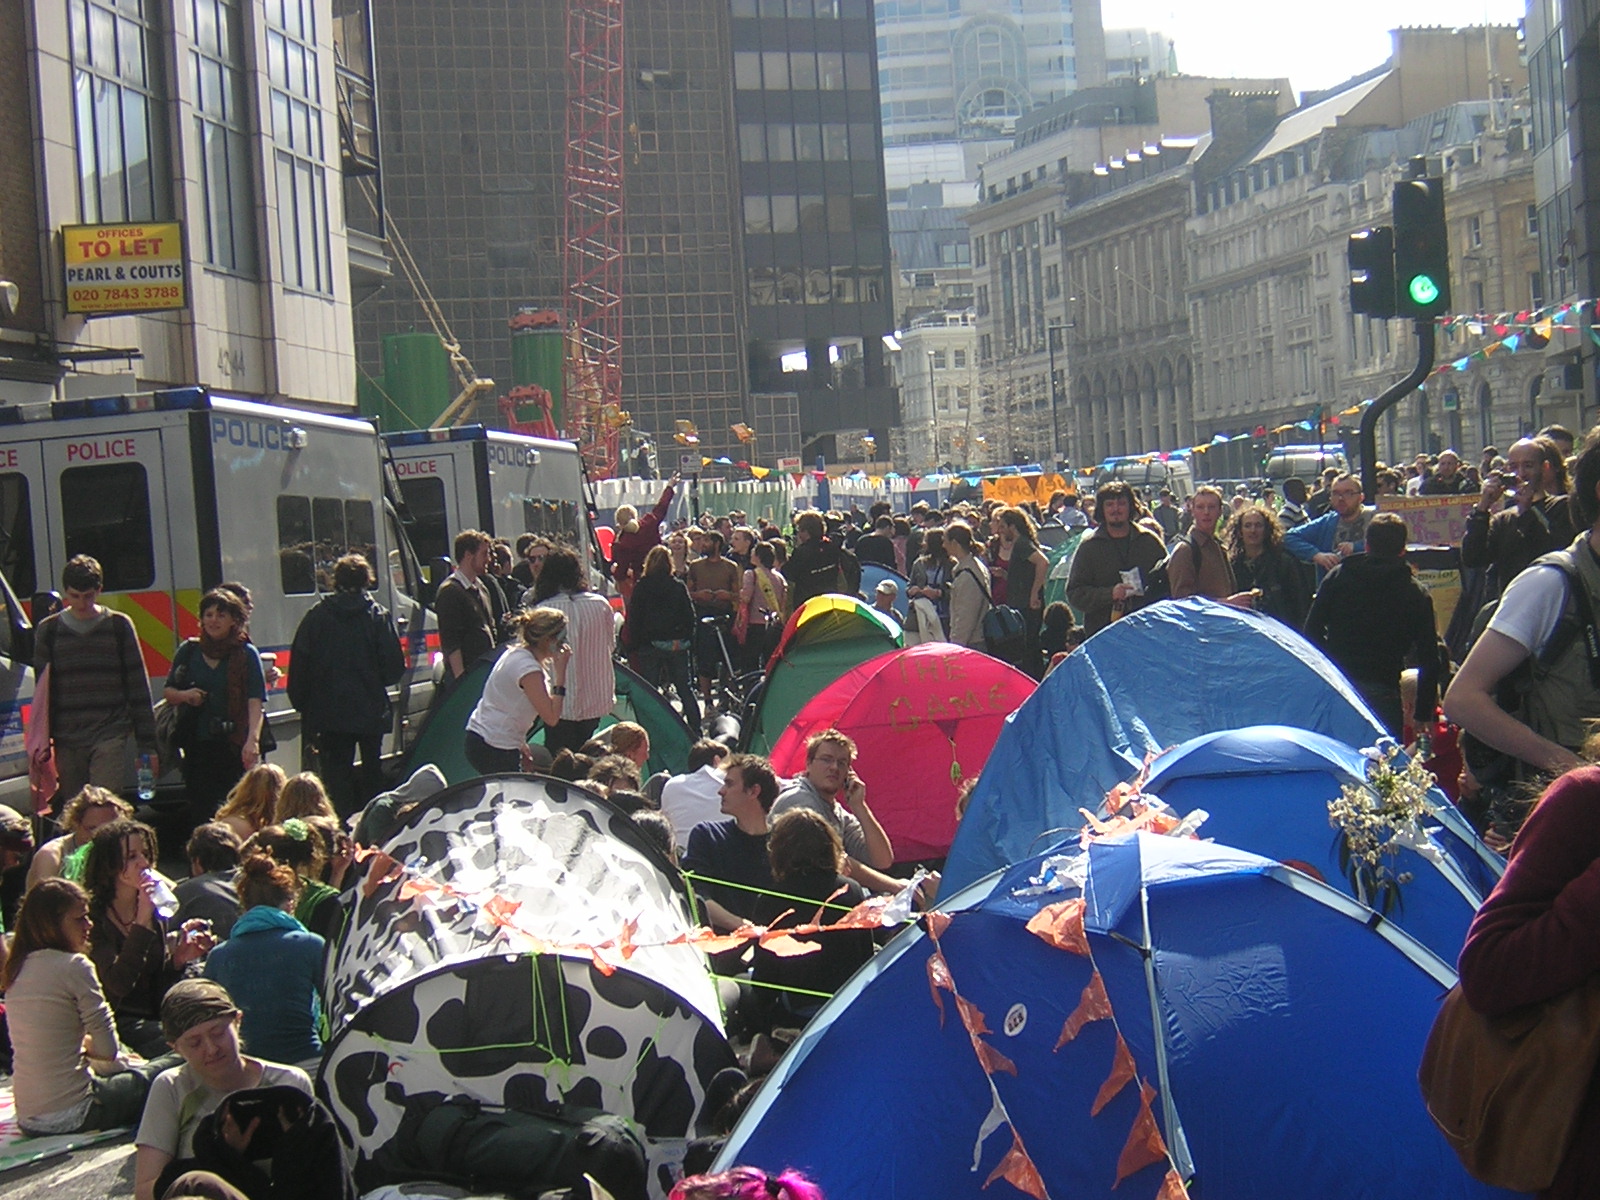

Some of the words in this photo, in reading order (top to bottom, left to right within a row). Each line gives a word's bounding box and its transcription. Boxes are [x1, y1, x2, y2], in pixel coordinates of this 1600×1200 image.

[97, 228, 143, 238] OFFICES
[78, 240, 111, 258] TO
[119, 238, 163, 256] LET
[68, 267, 112, 282] PEARL
[115, 266, 126, 280] &
[130, 264, 182, 279] COUTTS
[73, 289, 99, 301] 020
[103, 287, 139, 300] 7843
[144, 286, 179, 298] 3788
[212, 418, 295, 450] POLICE
[67, 438, 136, 461] POLICE
[397, 460, 437, 476] OLICE
[898, 656, 967, 686] THE
[889, 681, 1008, 732] GAME
